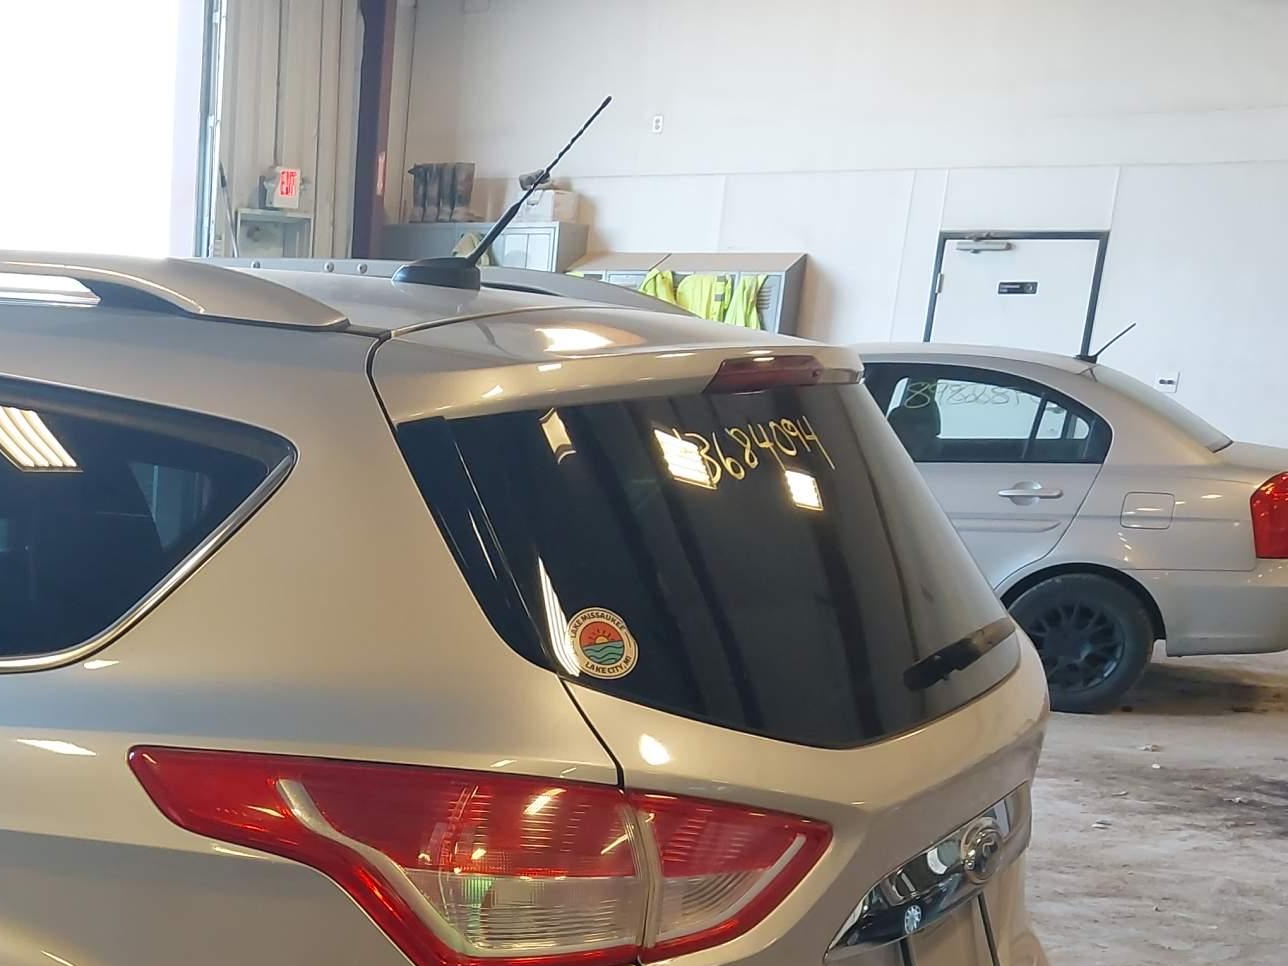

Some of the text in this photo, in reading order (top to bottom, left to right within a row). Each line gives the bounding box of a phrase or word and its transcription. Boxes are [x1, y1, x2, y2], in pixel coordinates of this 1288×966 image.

[570, 611, 626, 639] LAKE MISSAUKEE
[585, 661, 607, 674] LAKE
[623, 655, 632, 667] MI
